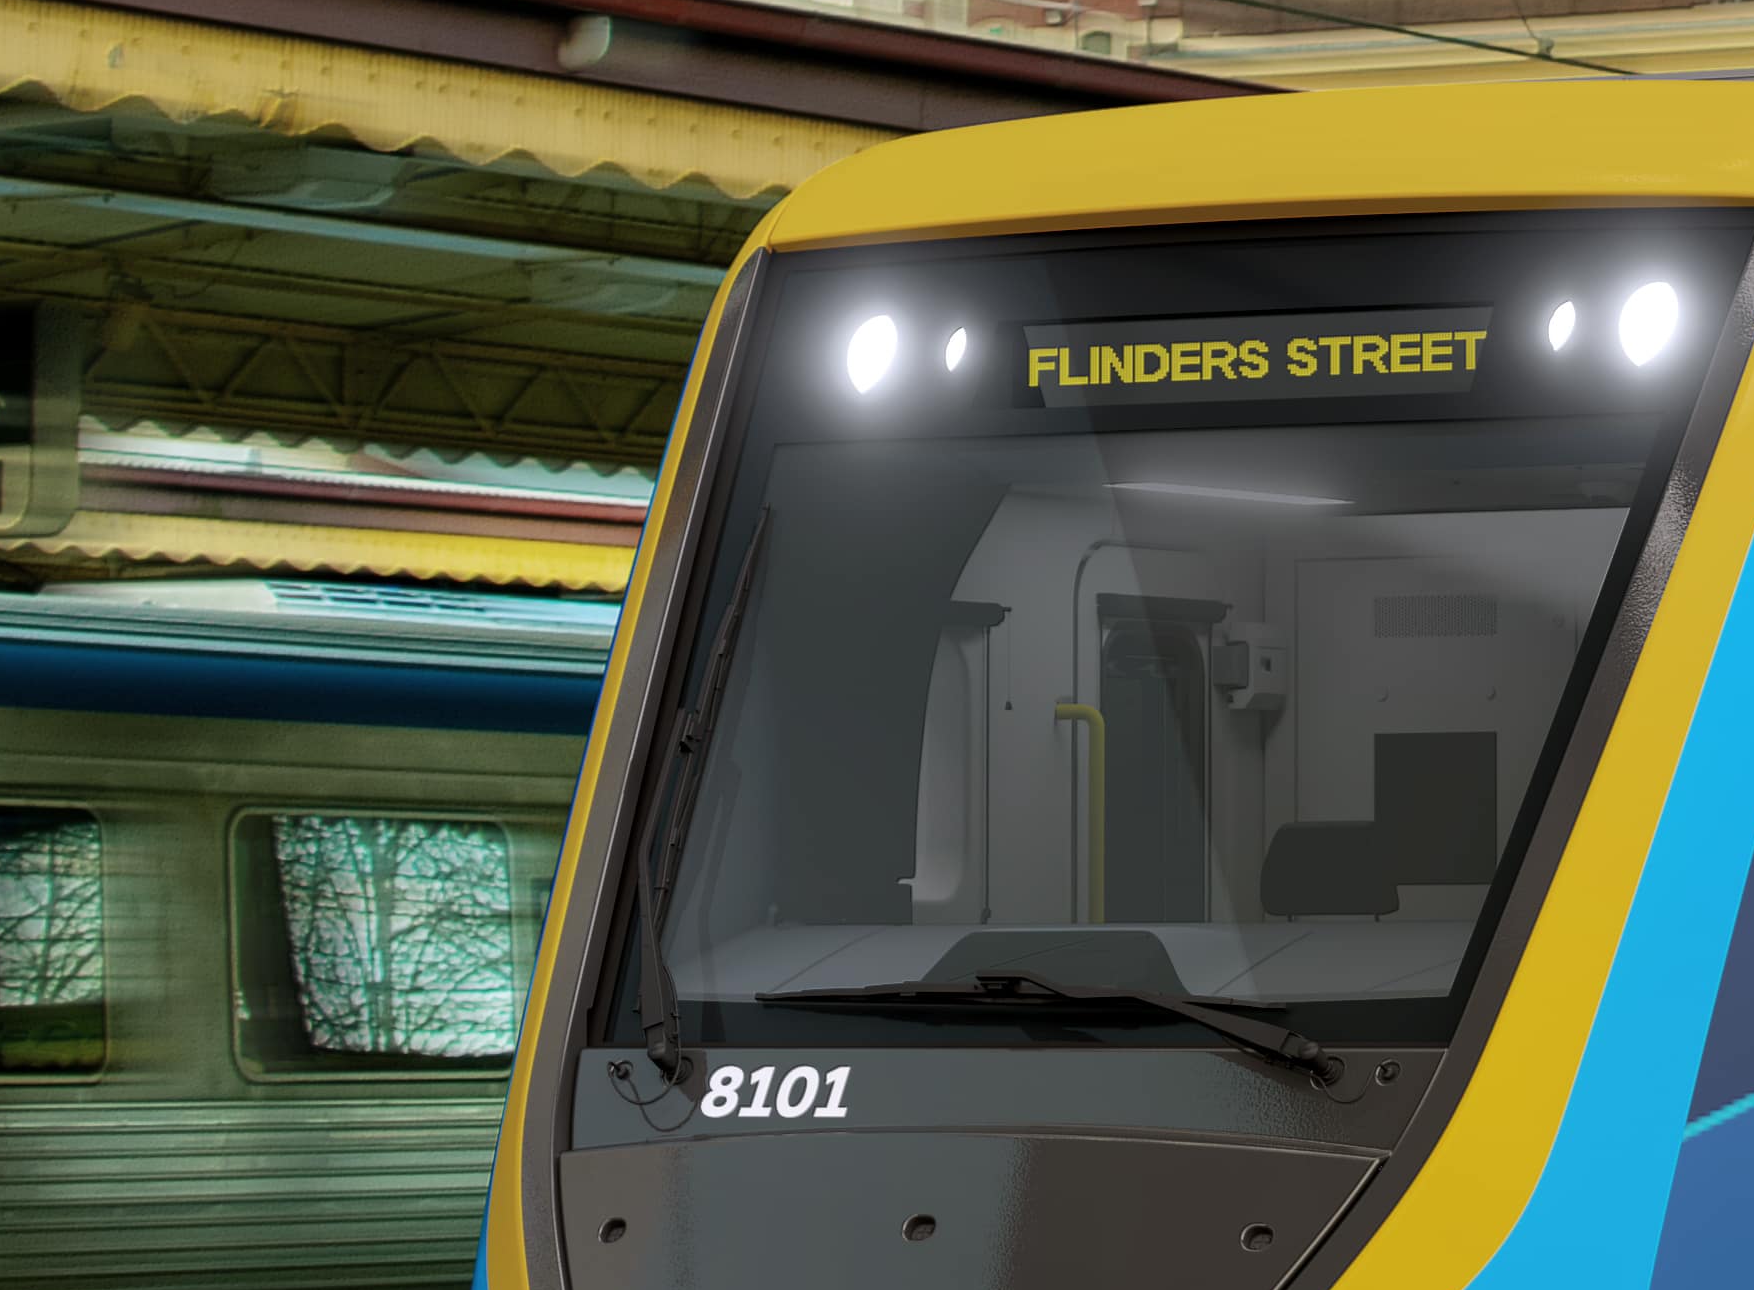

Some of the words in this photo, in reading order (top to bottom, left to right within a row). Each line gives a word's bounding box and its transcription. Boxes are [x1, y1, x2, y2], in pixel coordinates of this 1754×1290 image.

[1029, 340, 1269, 387] FLINDERS
[1286, 331, 1487, 376] STREET
[700, 1065, 851, 1119] 8101
